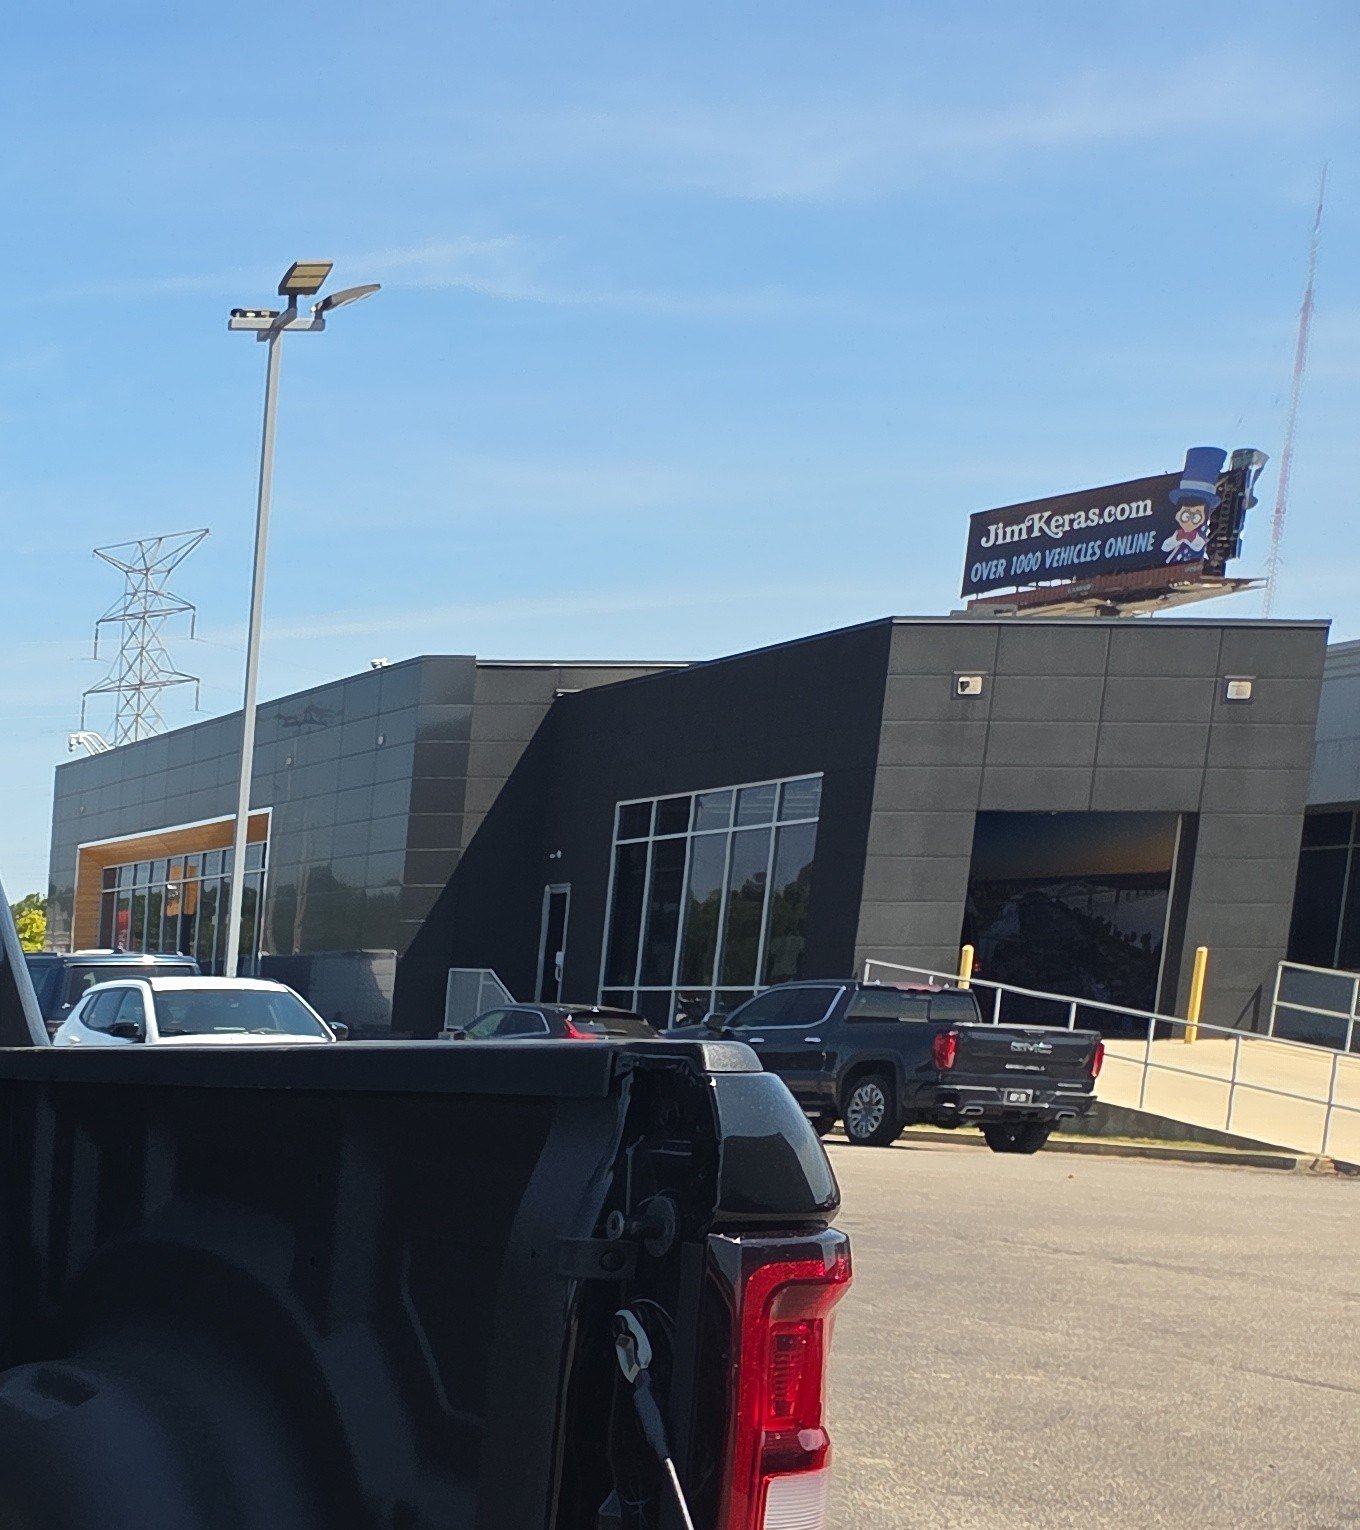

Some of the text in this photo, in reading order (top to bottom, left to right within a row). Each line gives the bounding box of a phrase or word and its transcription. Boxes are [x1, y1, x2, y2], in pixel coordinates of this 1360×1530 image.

[980, 499, 1153, 548] JimKeras.com
[970, 530, 1157, 583] OVER 1000 VEHICLES ONLINE
[1010, 1041, 1053, 1055] GMC
